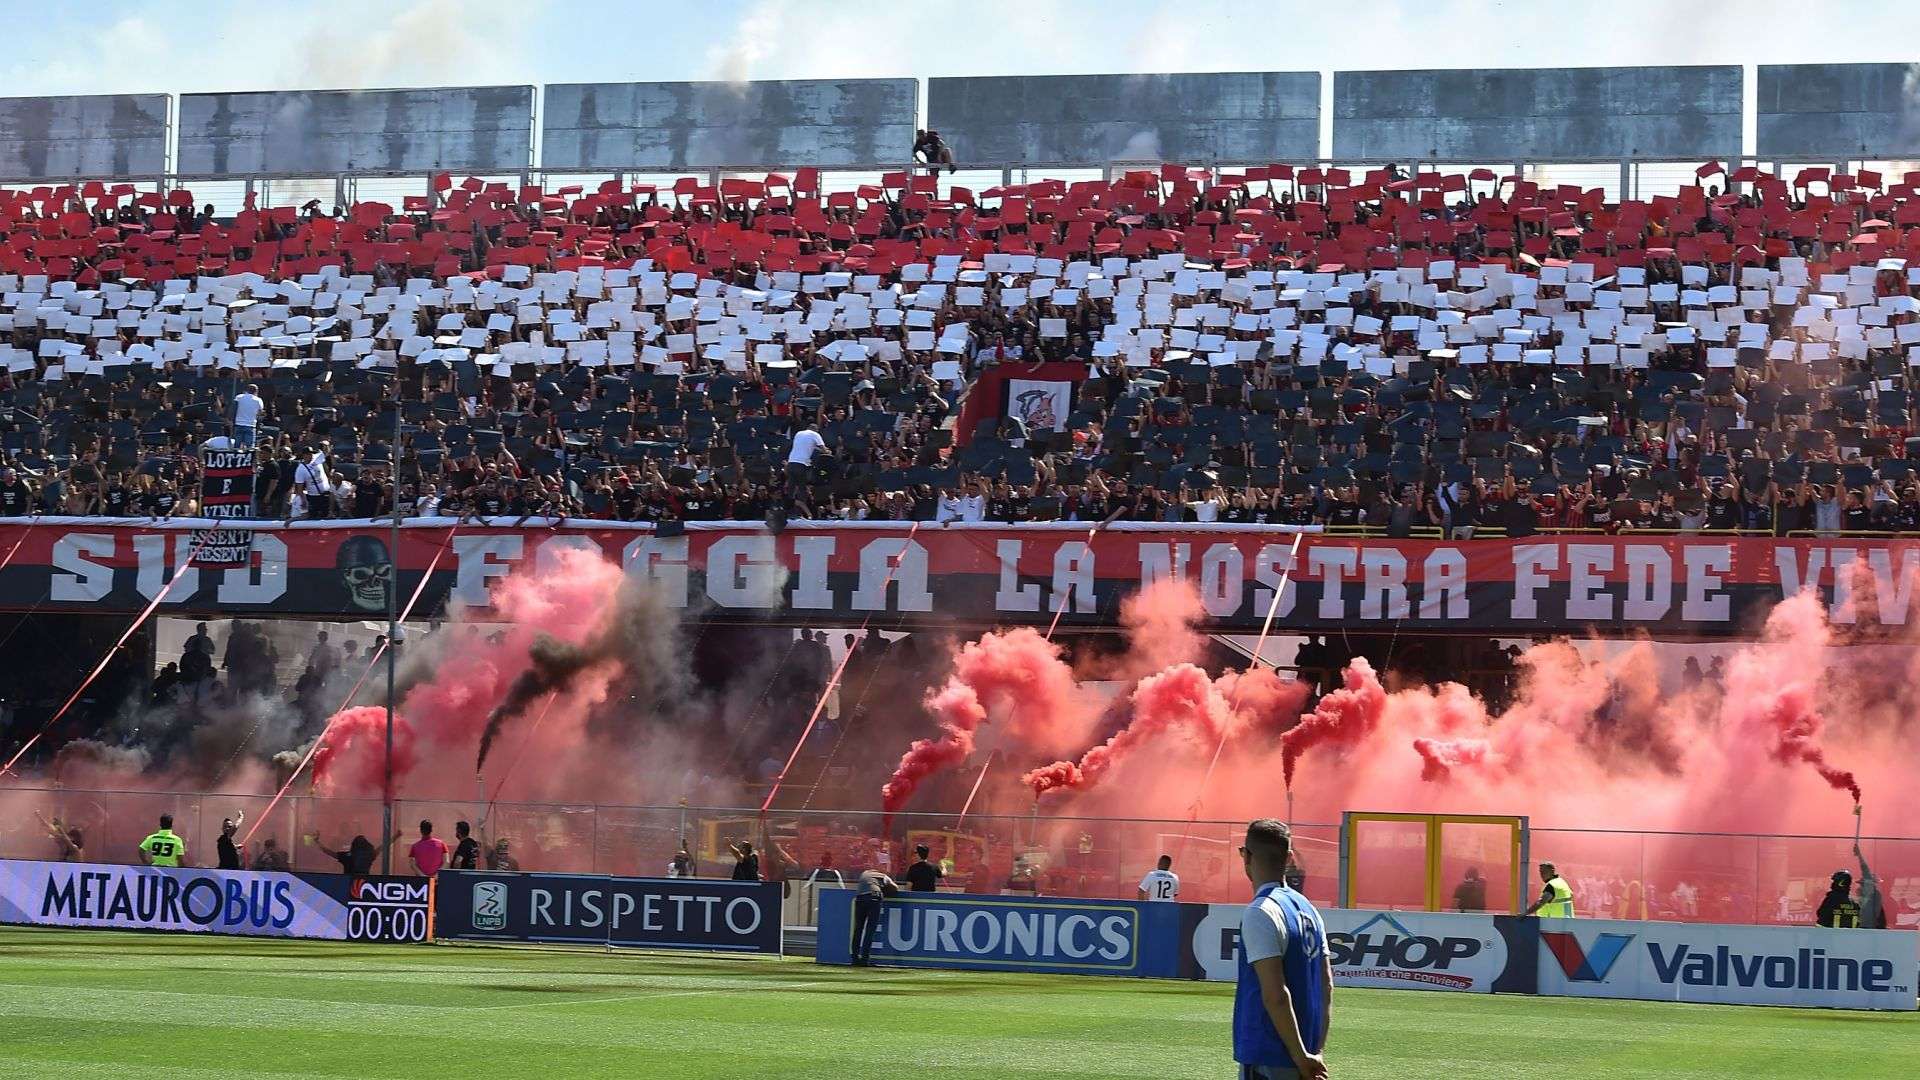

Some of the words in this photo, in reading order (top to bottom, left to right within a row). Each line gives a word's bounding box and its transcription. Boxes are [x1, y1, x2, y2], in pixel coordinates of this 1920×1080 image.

[207, 452, 252, 468] LOTTA
[222, 478, 232, 494] E
[203, 504, 250, 518] VINCI
[50, 532, 289, 604] SUD
[996, 539, 1097, 614] LA
[1138, 541, 1470, 620] NOSTRA
[1511, 543, 1732, 622] FEDE
[152, 841, 175, 857] 93
[360, 882, 429, 902] NGM
[1157, 880, 1172, 899] 12
[41, 872, 295, 930] METAUROBUS
[529, 888, 762, 935] RISPETTO
[348, 907, 427, 941] 00:00
[1647, 942, 1893, 992] Valvoline
[1414, 972, 1466, 989] conviene
